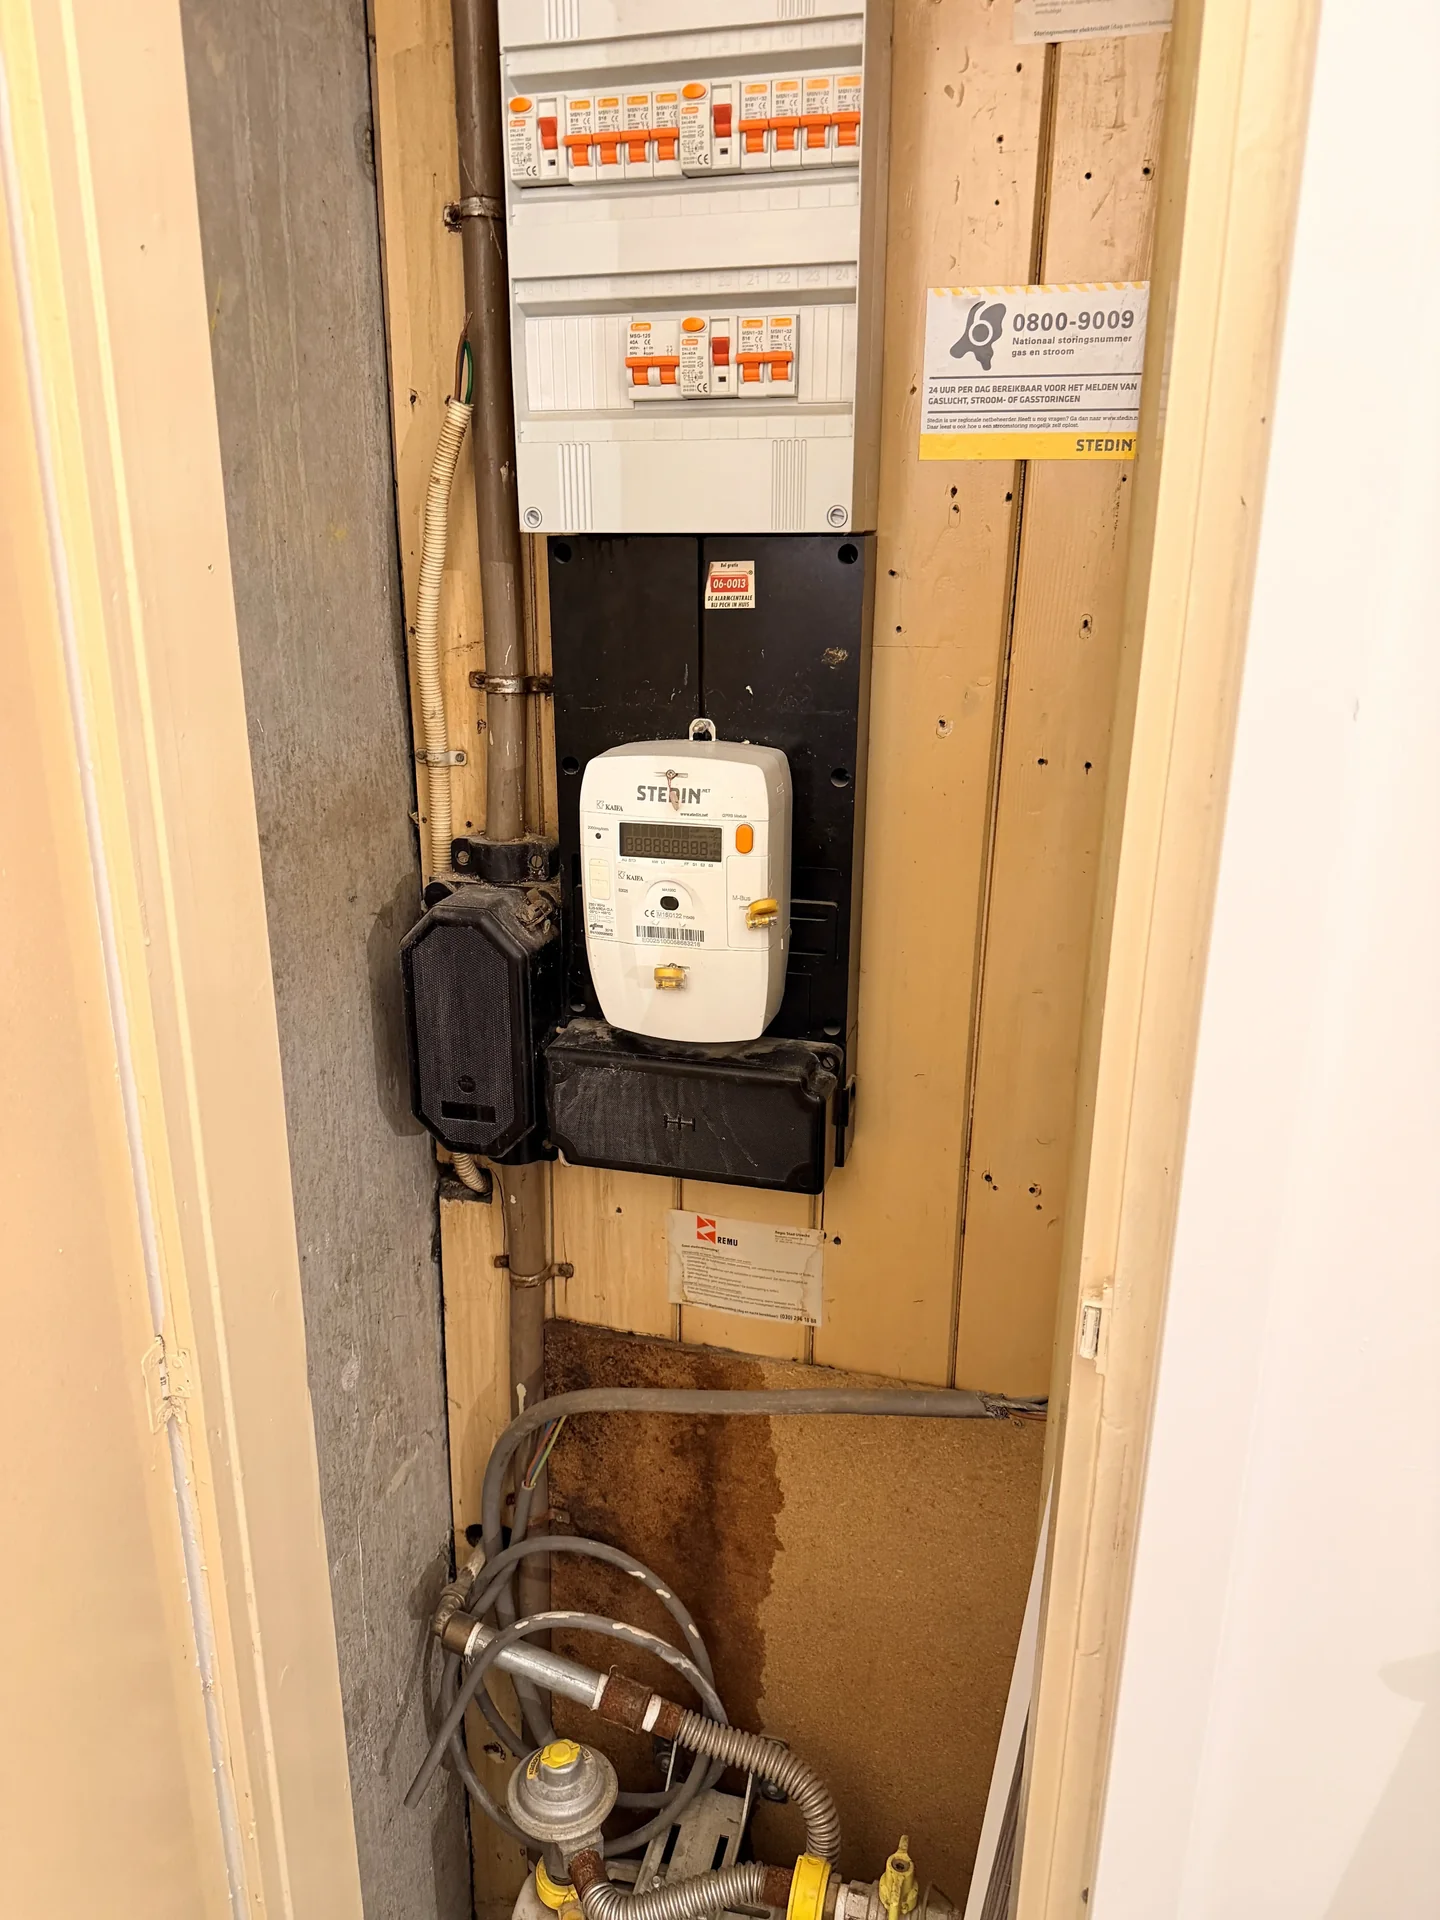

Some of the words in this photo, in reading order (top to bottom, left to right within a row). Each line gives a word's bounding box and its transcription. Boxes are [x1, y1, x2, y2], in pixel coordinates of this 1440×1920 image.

[776, 271, 791, 284] 22
[1013, 310, 1134, 332] 0800-9009
[1012, 337, 1055, 345] Nationaal
[1058, 336, 1132, 345] storingsnummer
[1012, 350, 1026, 358] gas
[992, 384, 1042, 392] BEREIKBAAR
[1076, 439, 1133, 452] STEDIN
[713, 579, 746, 588] 06-0013
[717, 1237, 738, 1246] REMU
